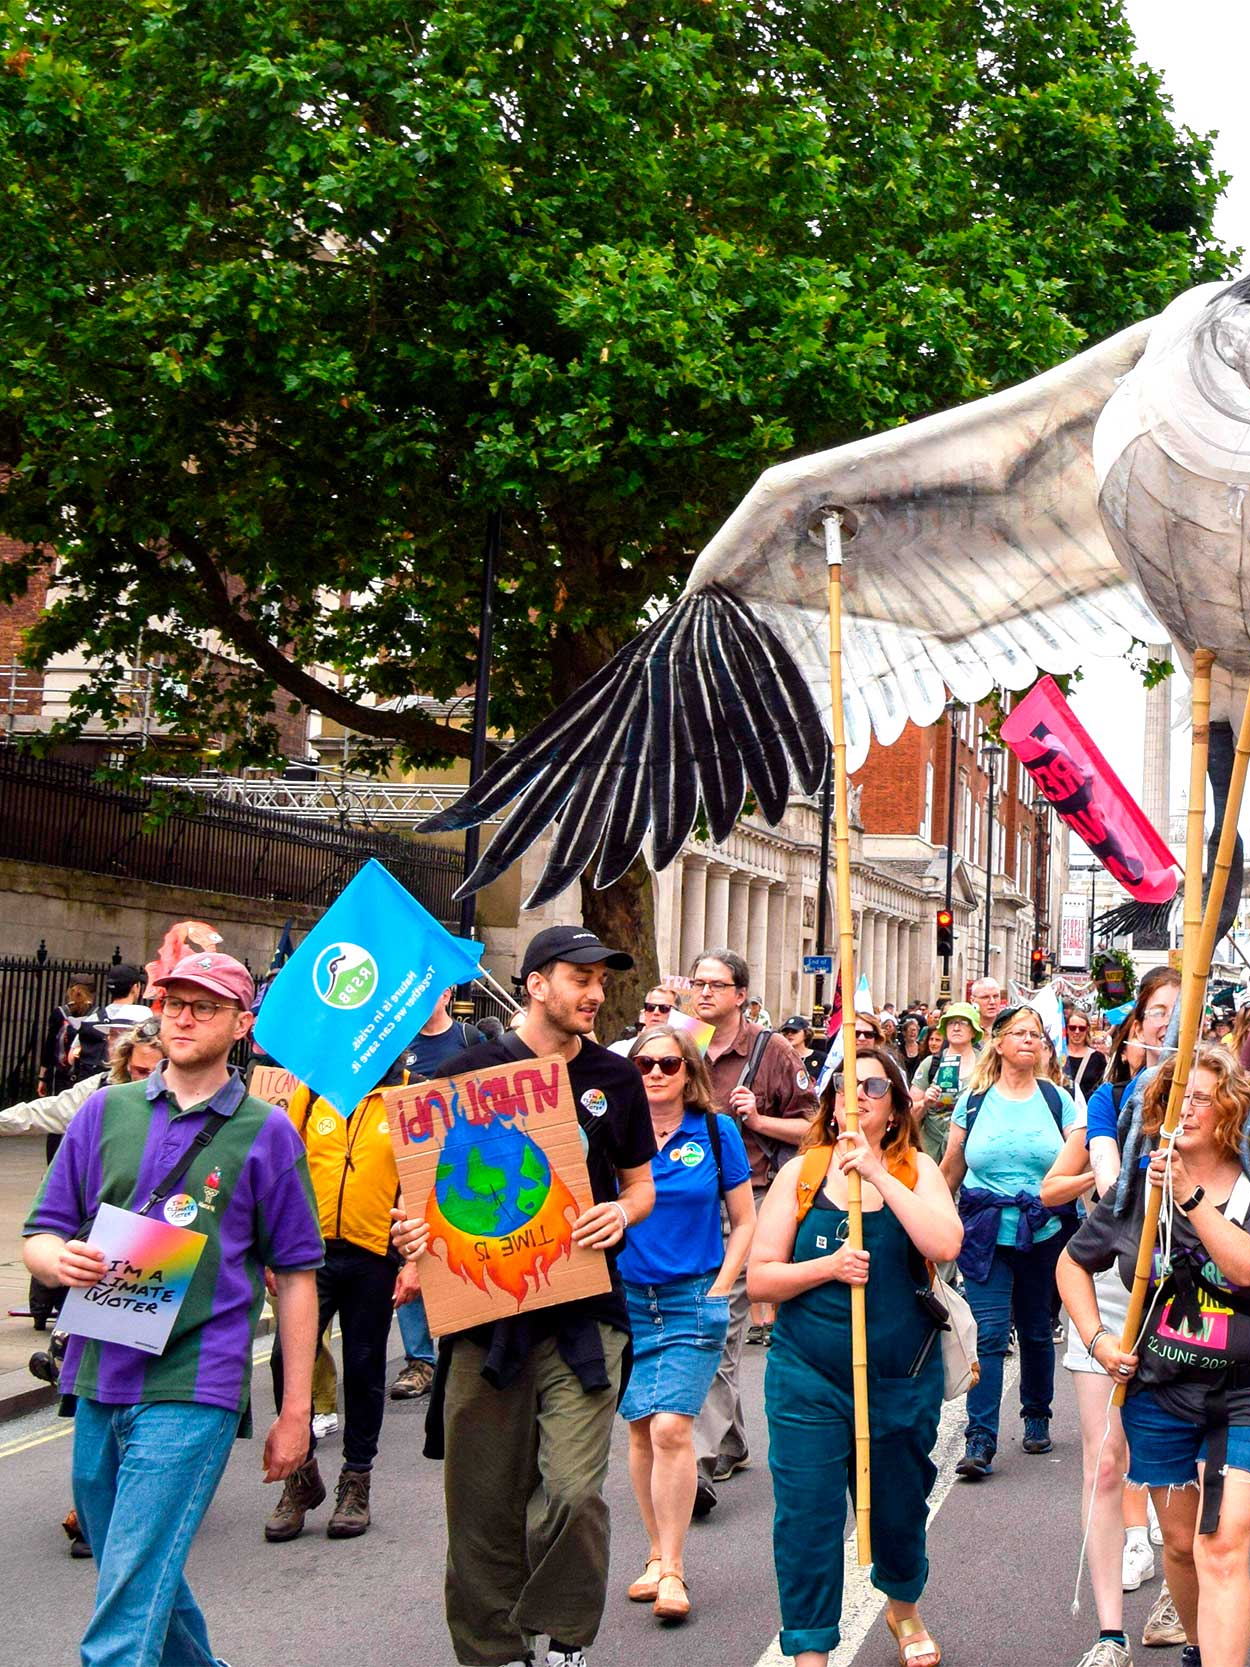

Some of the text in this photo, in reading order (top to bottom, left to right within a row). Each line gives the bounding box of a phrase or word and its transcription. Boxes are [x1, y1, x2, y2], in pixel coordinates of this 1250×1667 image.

[259, 1070, 275, 1095] IT
[398, 1089, 451, 1146] UP!
[474, 1225, 554, 1262] TIME IS
[108, 1260, 163, 1283] I'M A
[97, 1276, 176, 1303] LIMATE
[1158, 1345, 1198, 1366] JUNE
